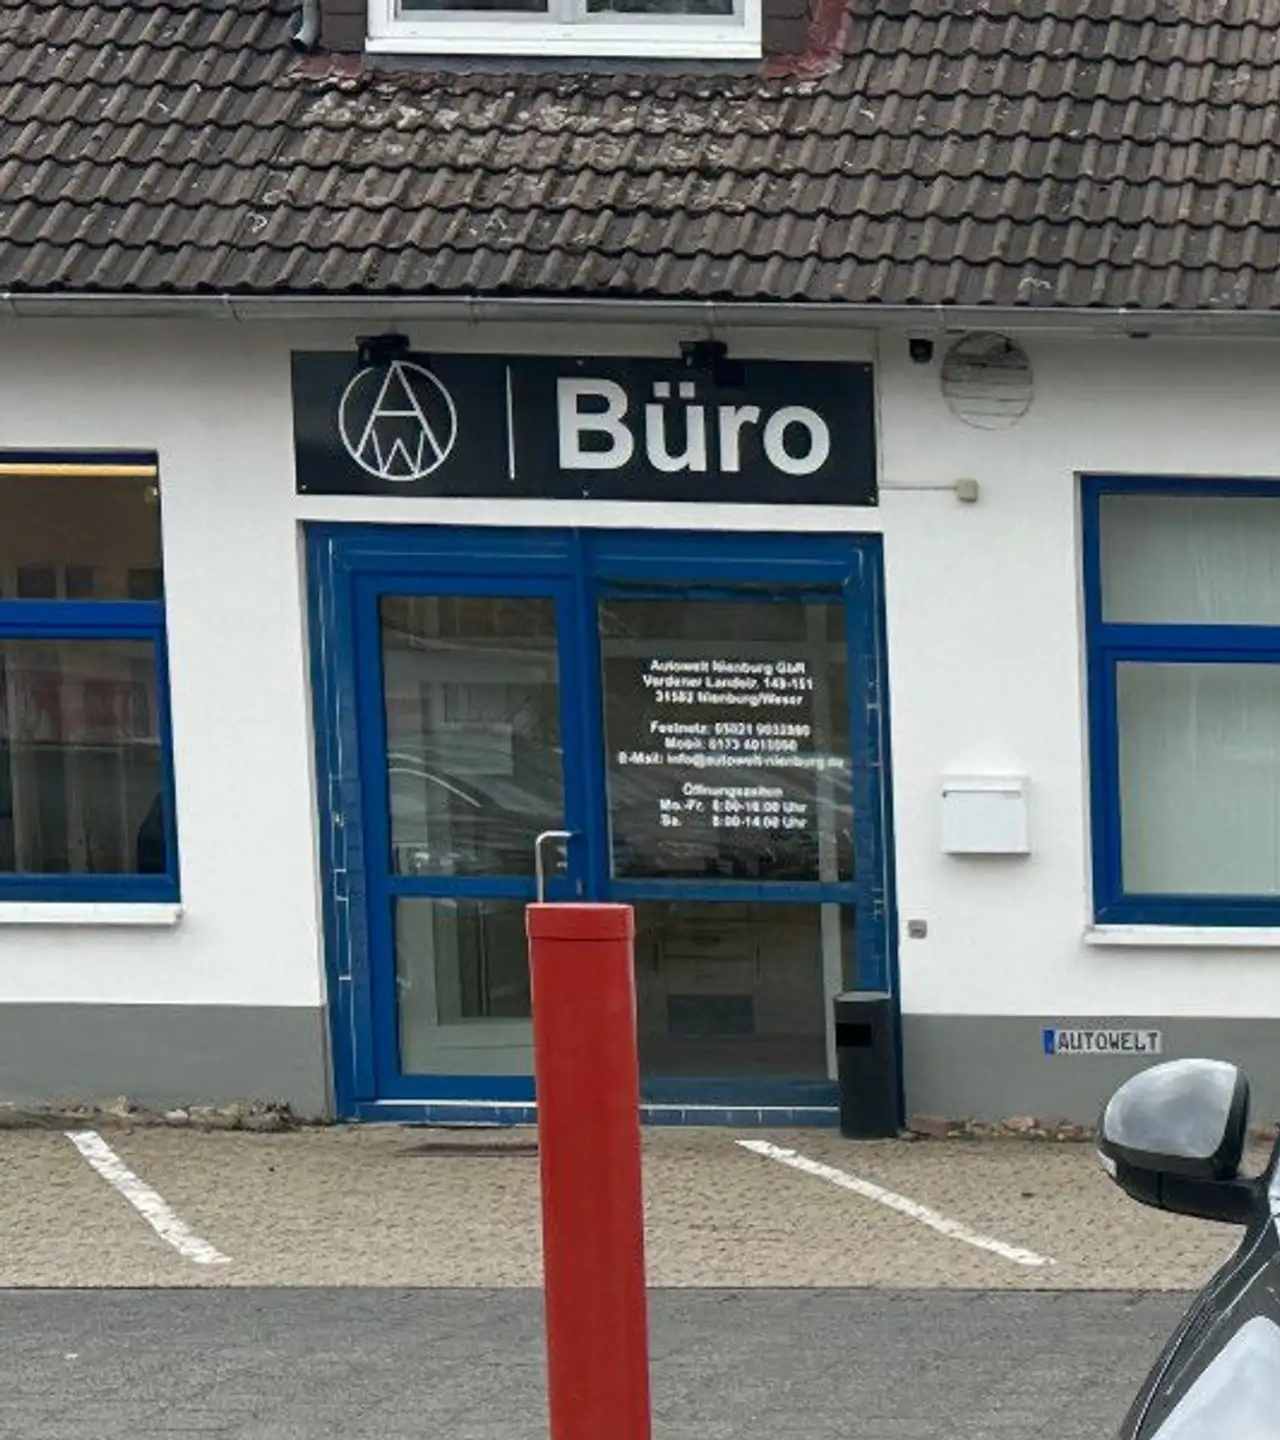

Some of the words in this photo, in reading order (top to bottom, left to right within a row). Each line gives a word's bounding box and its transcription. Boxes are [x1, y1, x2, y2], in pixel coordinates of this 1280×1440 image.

[556, 376, 832, 476] Büro
[650, 660, 709, 673] Autowelt
[712, 661, 774, 675] Nienburg
[776, 662, 806, 674] GbR
[698, 691, 803, 706] Nienburg/Weser
[1058, 1031, 1158, 1051] AUTOWELT
